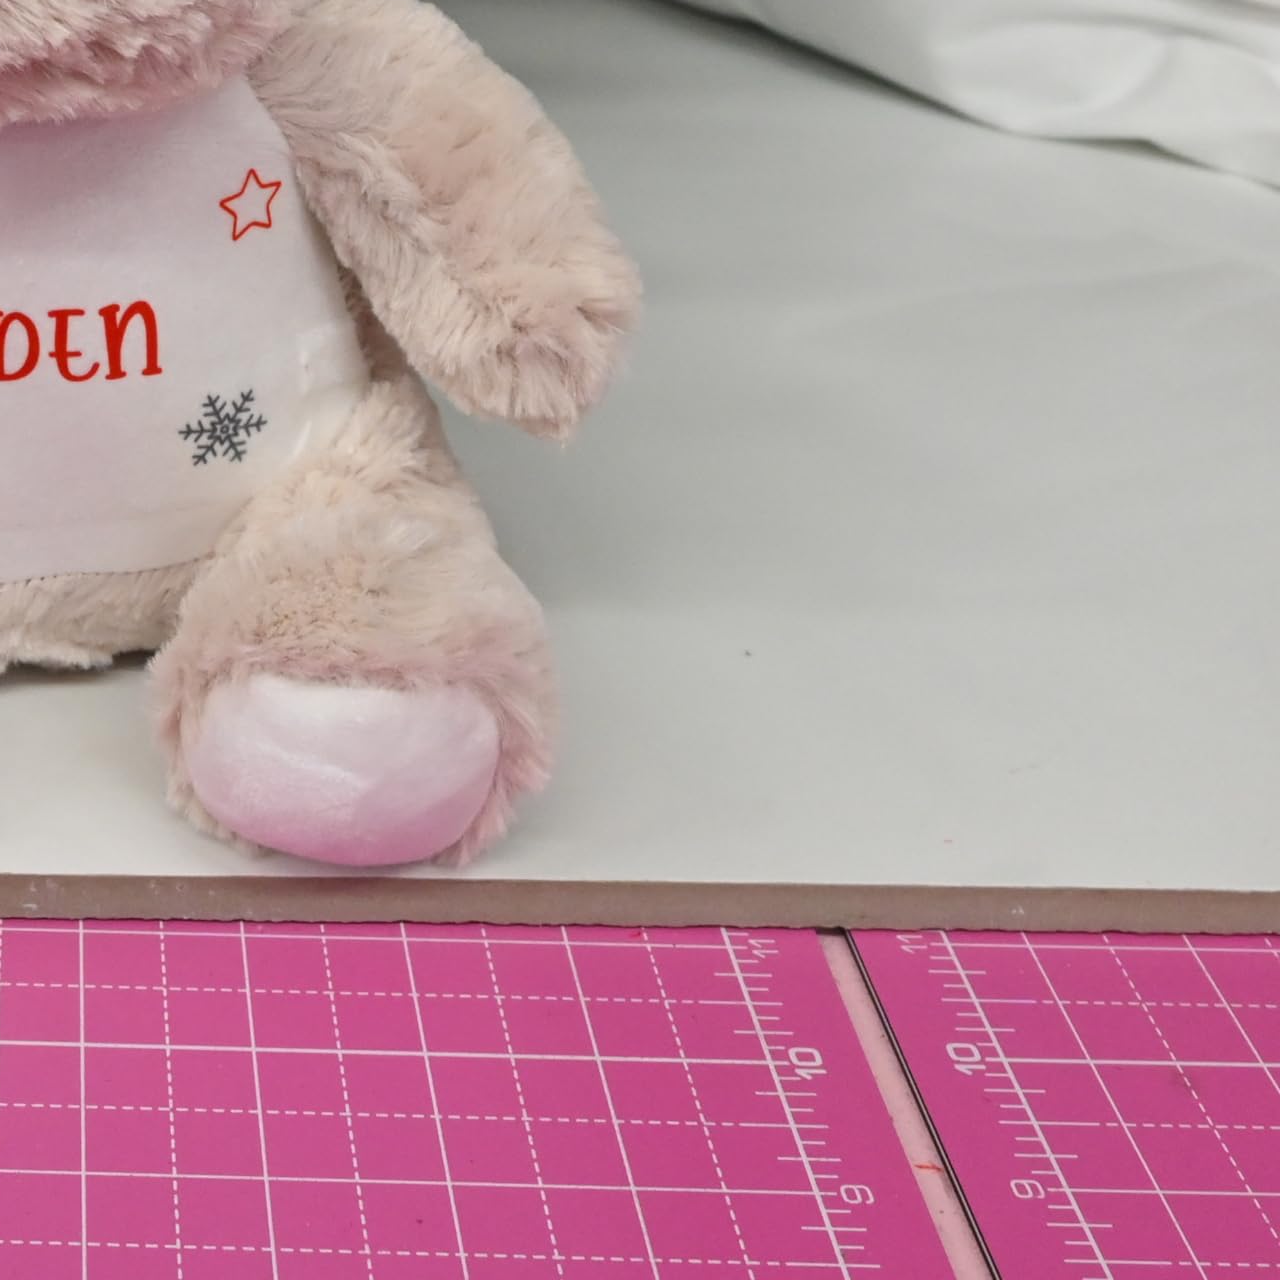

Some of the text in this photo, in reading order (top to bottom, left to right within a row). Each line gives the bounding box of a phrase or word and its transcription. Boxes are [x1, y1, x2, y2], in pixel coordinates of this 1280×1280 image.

[748, 939, 780, 959] 11
[895, 934, 928, 954] 11
[788, 1047, 827, 1080] 10
[946, 1042, 987, 1076] 10
[840, 1184, 875, 1204] 9
[1010, 1179, 1045, 1199] 9
